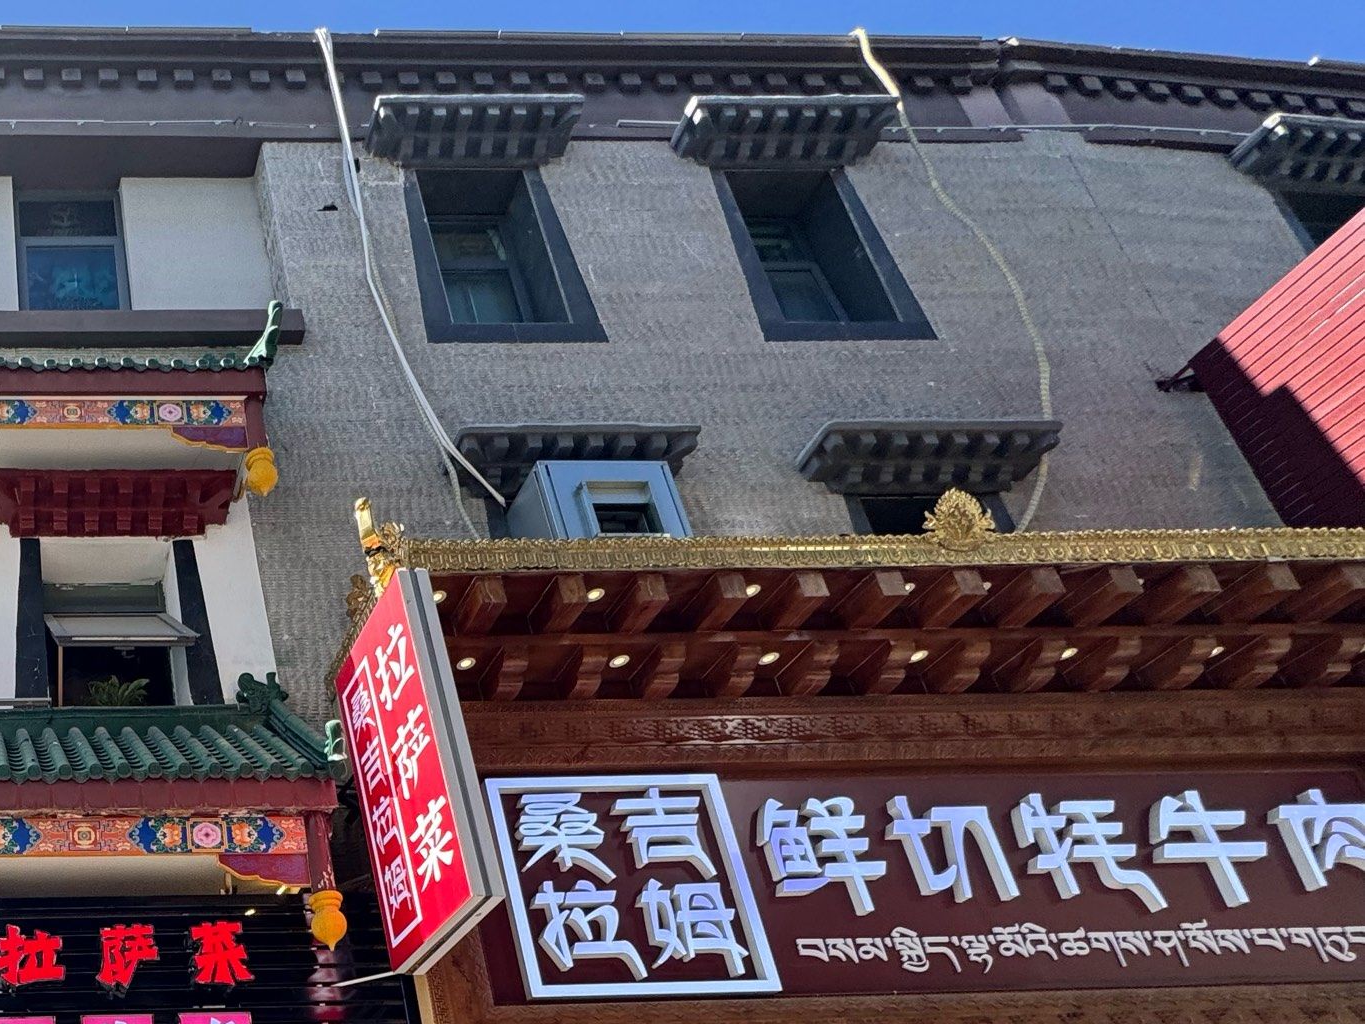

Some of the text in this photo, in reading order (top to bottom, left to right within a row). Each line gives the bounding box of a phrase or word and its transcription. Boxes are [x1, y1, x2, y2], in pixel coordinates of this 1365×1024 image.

[350, 684, 413, 920] 桑吉拉姆
[374, 622, 455, 894] 拉萨菜
[515, 787, 718, 884] 桑吉
[756, 787, 1365, 916] 鲜切牦牛肉
[530, 878, 749, 981] 拉姆
